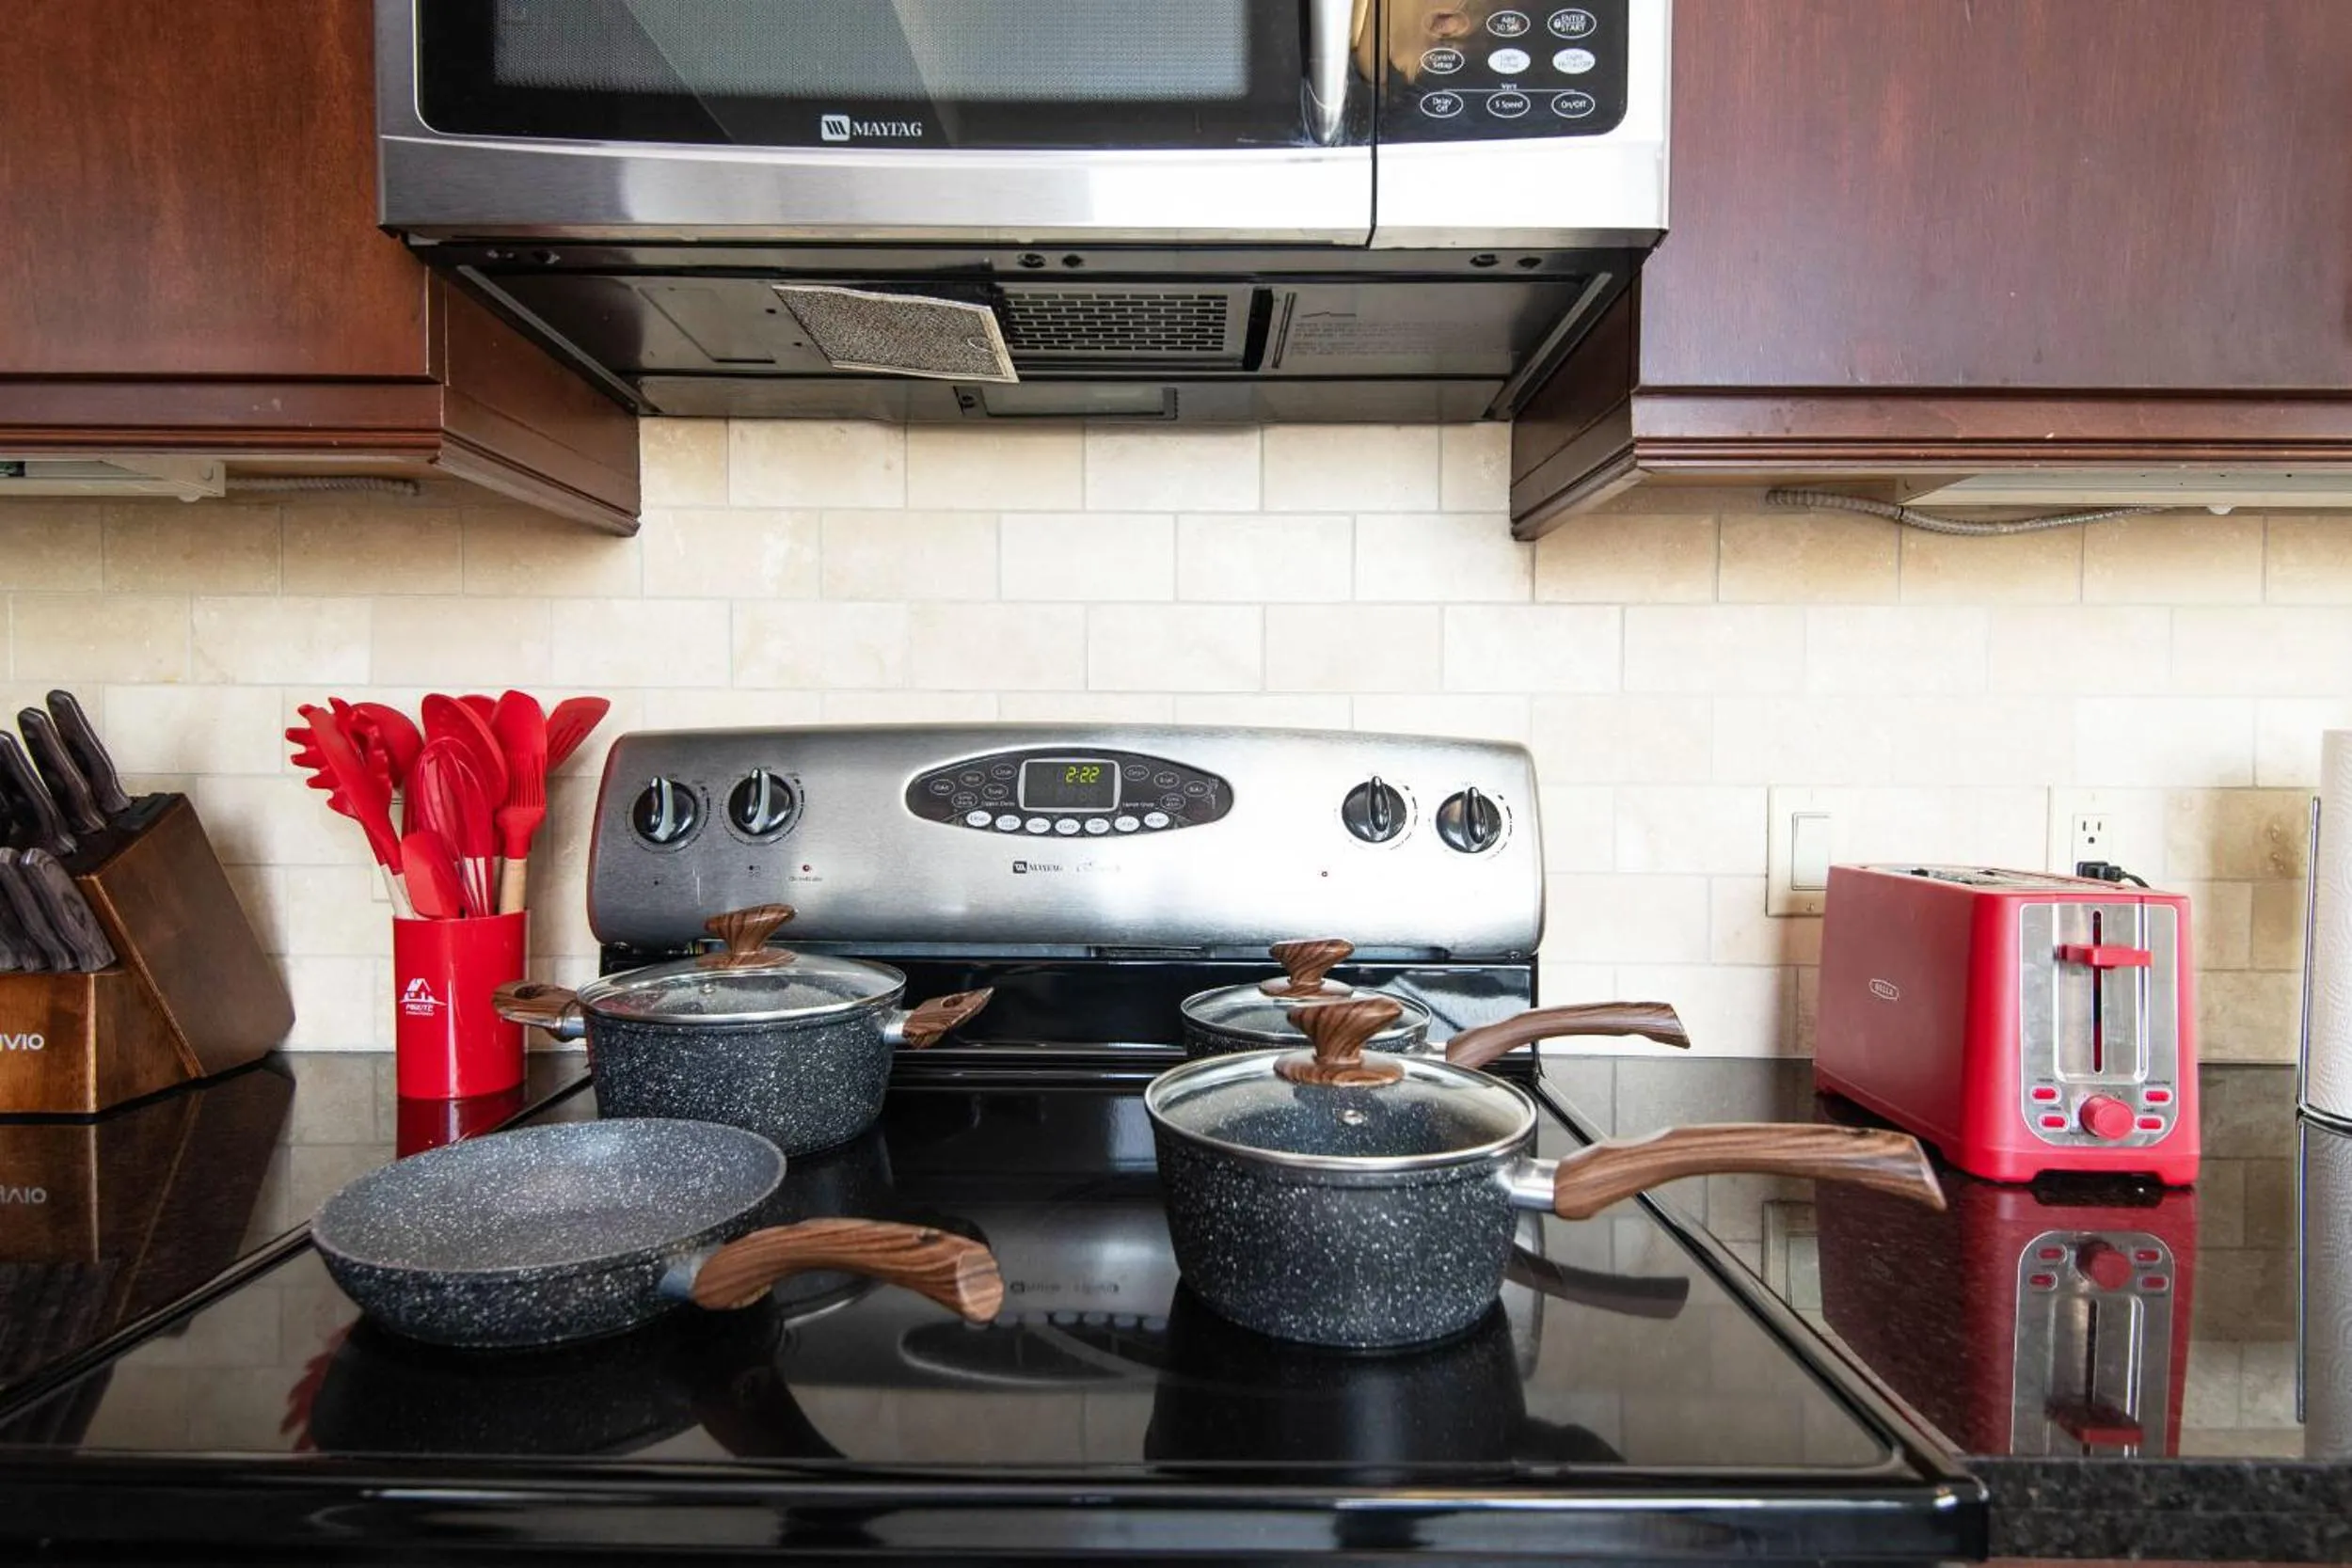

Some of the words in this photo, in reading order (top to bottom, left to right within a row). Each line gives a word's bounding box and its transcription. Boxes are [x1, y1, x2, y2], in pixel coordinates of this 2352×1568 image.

[1432, 97, 1453, 106] Delay
[1502, 100, 1524, 110] Speed
[1561, 100, 1587, 109] On/Off
[1436, 104, 1449, 113] Off
[852, 120, 923, 137] MAYTAG
[1065, 765, 1101, 784] 2:22
